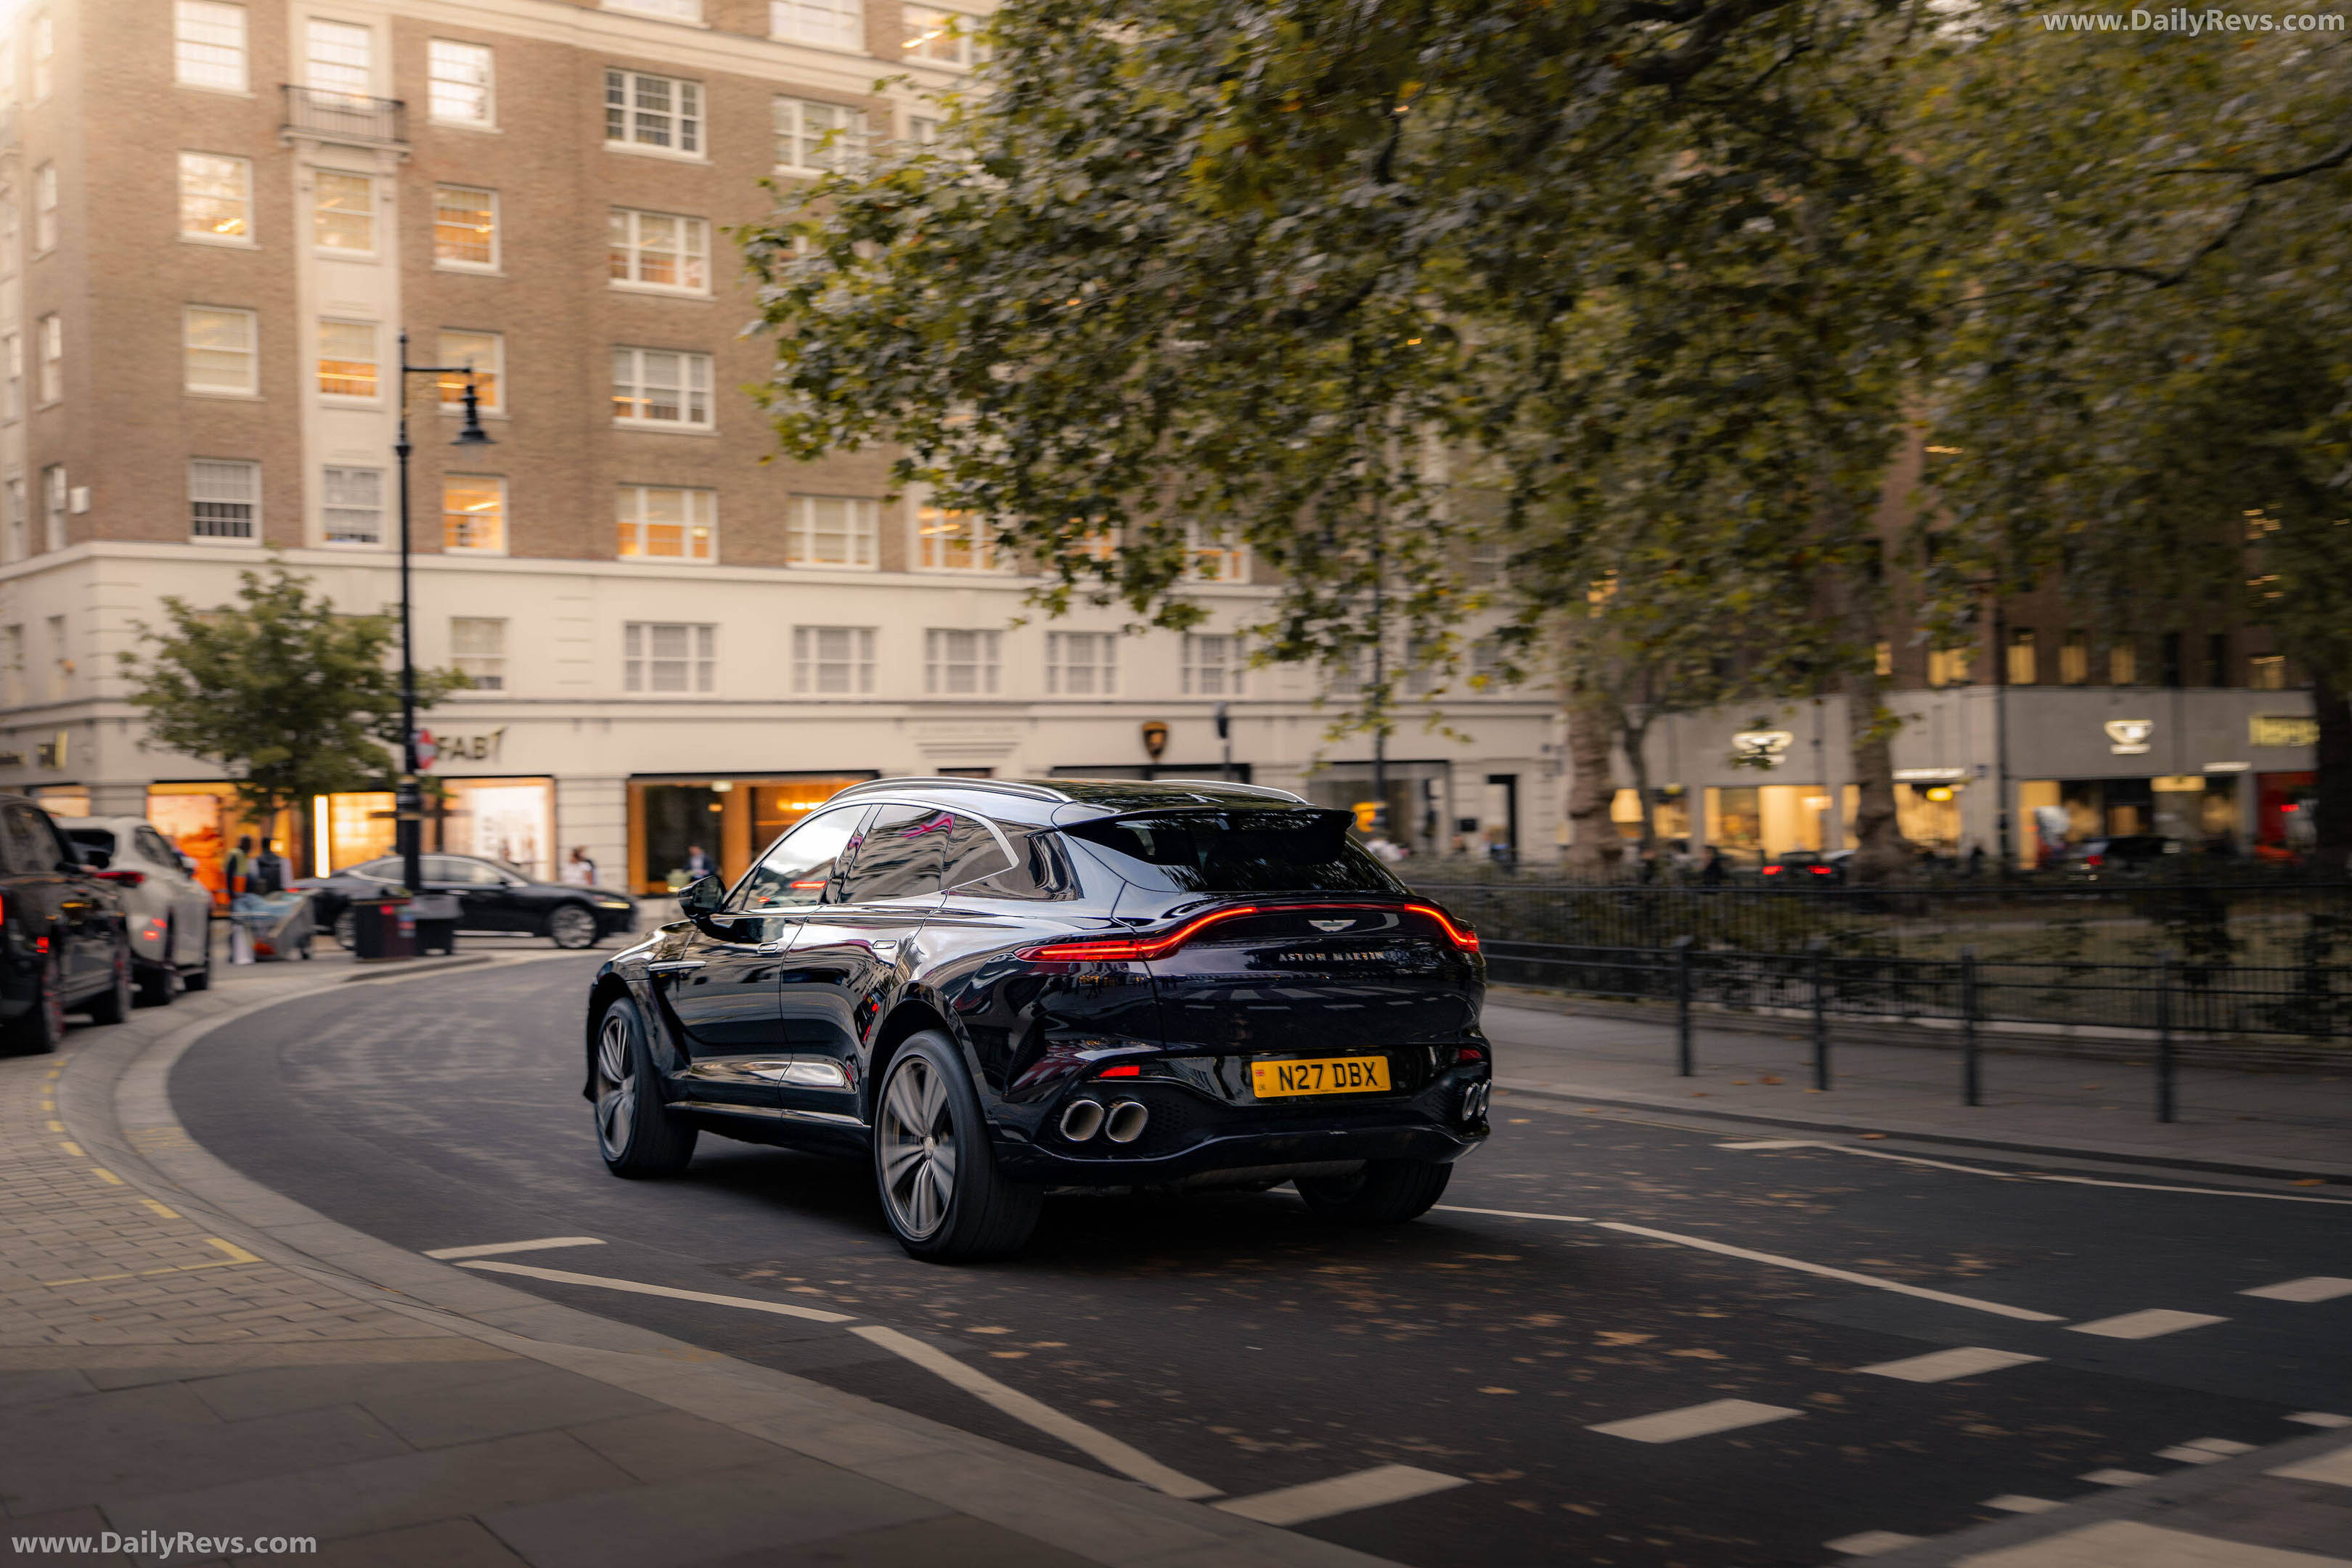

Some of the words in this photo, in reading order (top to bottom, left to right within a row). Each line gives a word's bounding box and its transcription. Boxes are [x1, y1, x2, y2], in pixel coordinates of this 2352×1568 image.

[1278, 952, 1327, 962] ASTON
[1333, 951, 1385, 961] MARTIN
[1278, 1063, 1323, 1091] N27
[1331, 1061, 1377, 1088] DBX
